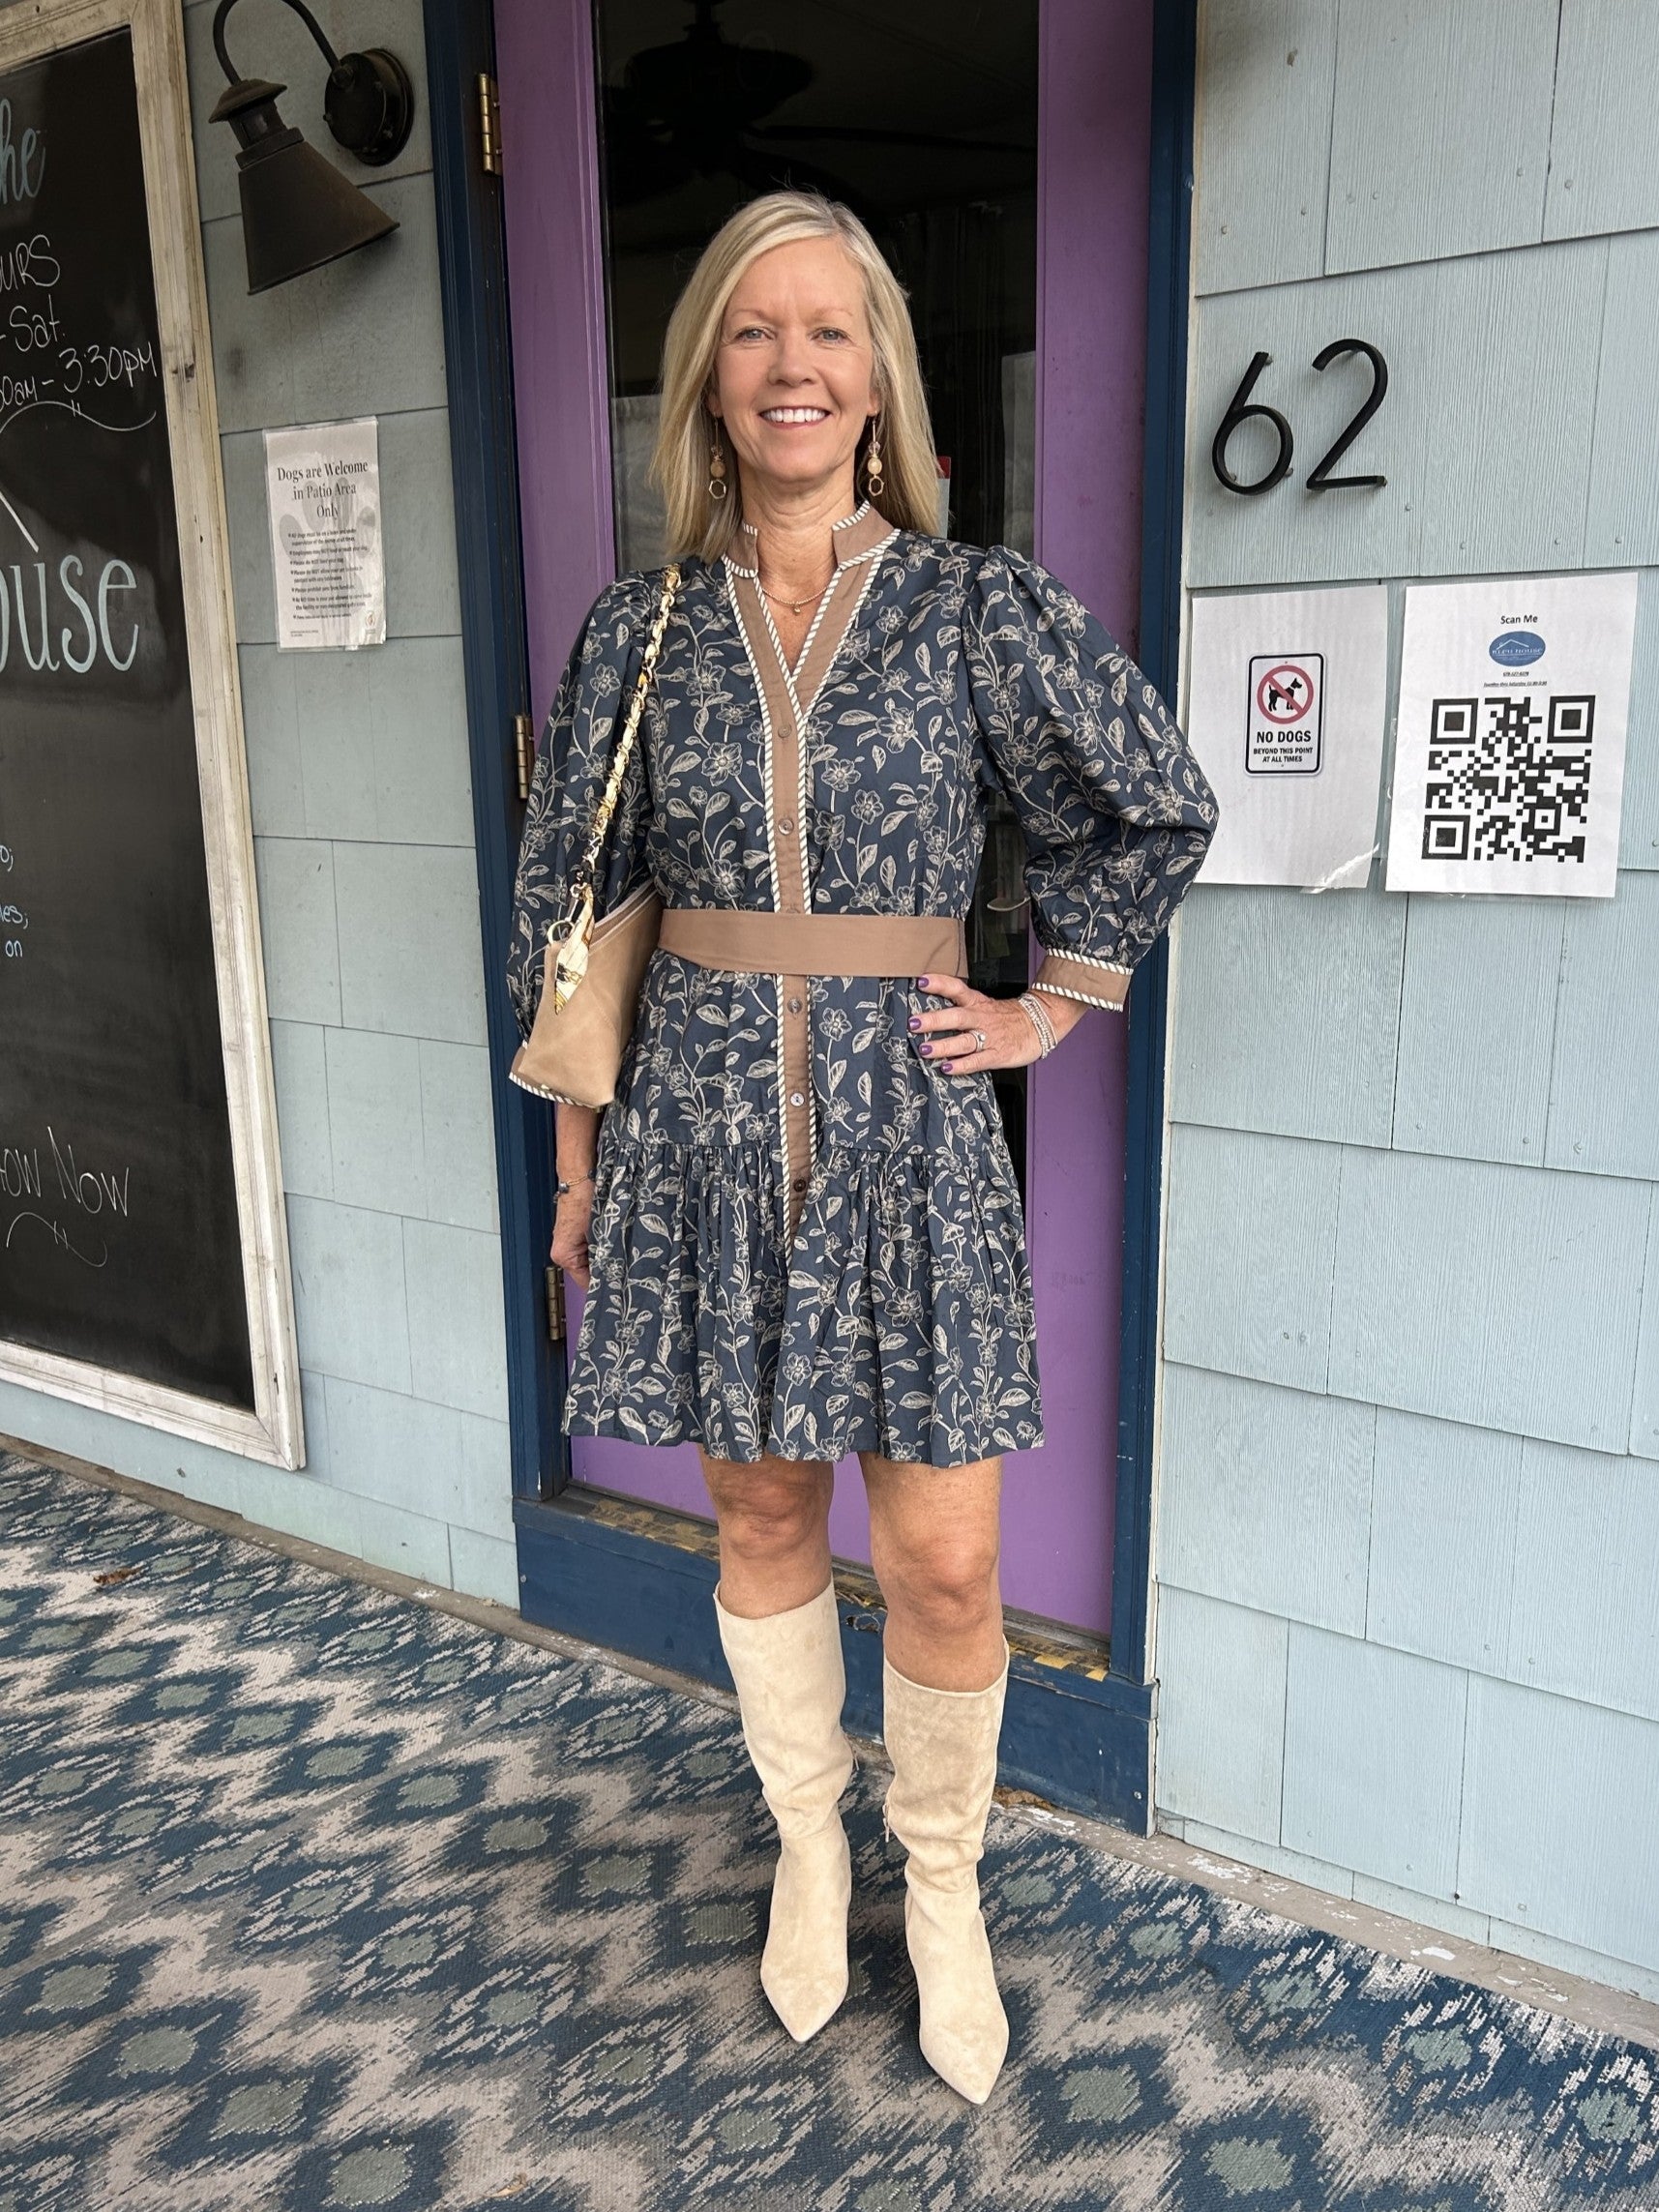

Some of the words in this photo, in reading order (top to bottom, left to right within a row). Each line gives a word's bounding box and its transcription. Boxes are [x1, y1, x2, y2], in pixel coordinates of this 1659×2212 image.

[0, 234, 60, 293] URS
[1212, 339, 1388, 496] 62
[277, 467, 304, 484] Dogs
[306, 467, 322, 478] are
[324, 460, 369, 476] Welcome
[293, 486, 304, 500] in
[307, 483, 332, 499] Patio
[335, 482, 357, 496] Area
[316, 502, 340, 520] Only
[1500, 615, 1521, 624] Scan
[1524, 614, 1538, 624] Me
[1257, 731, 1273, 744] NO
[1278, 730, 1312, 743] DOGS
[5, 939, 23, 958] on
